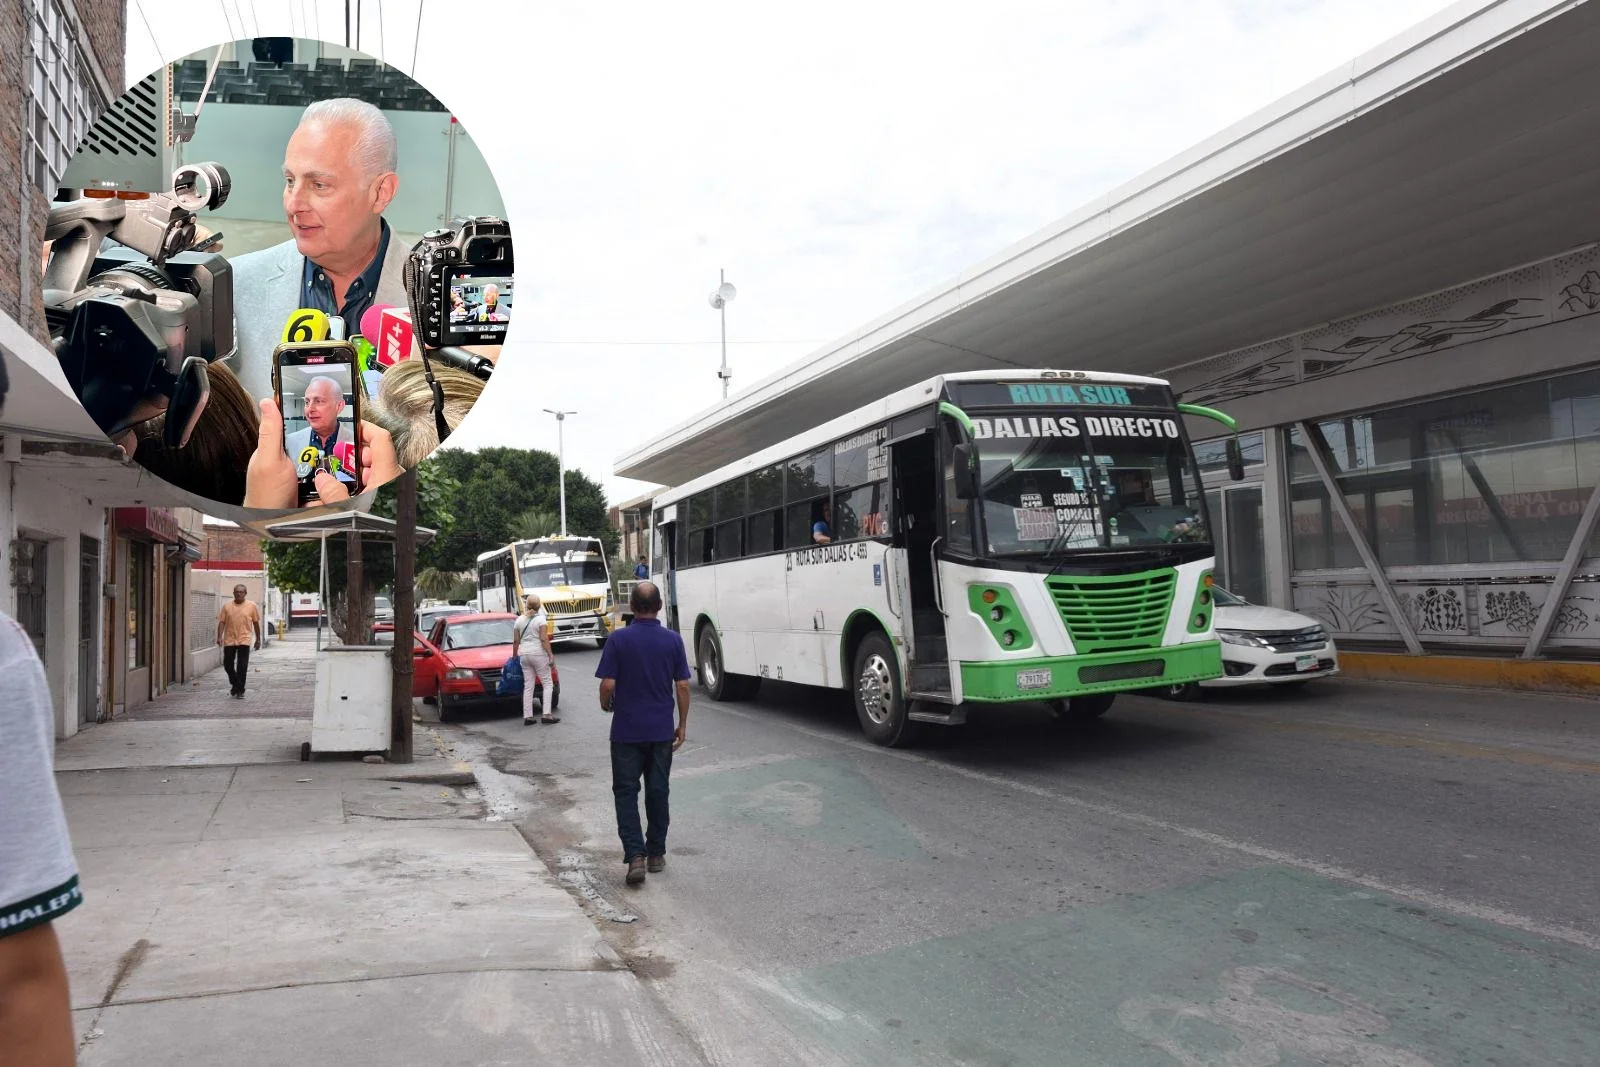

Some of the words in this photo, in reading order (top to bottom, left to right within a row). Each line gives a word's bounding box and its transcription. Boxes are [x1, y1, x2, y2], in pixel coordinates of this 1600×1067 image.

[1008, 384, 1080, 405] RUTA
[1079, 385, 1131, 405] SUR
[974, 417, 1081, 439] DALIAS
[1084, 417, 1180, 438] DIRECTO
[1053, 493, 1080, 506] SEGURO
[786, 552, 793, 571] 23
[796, 549, 810, 566] RUTA
[811, 547, 823, 564] SUR
[824, 544, 847, 563] DALIAS
